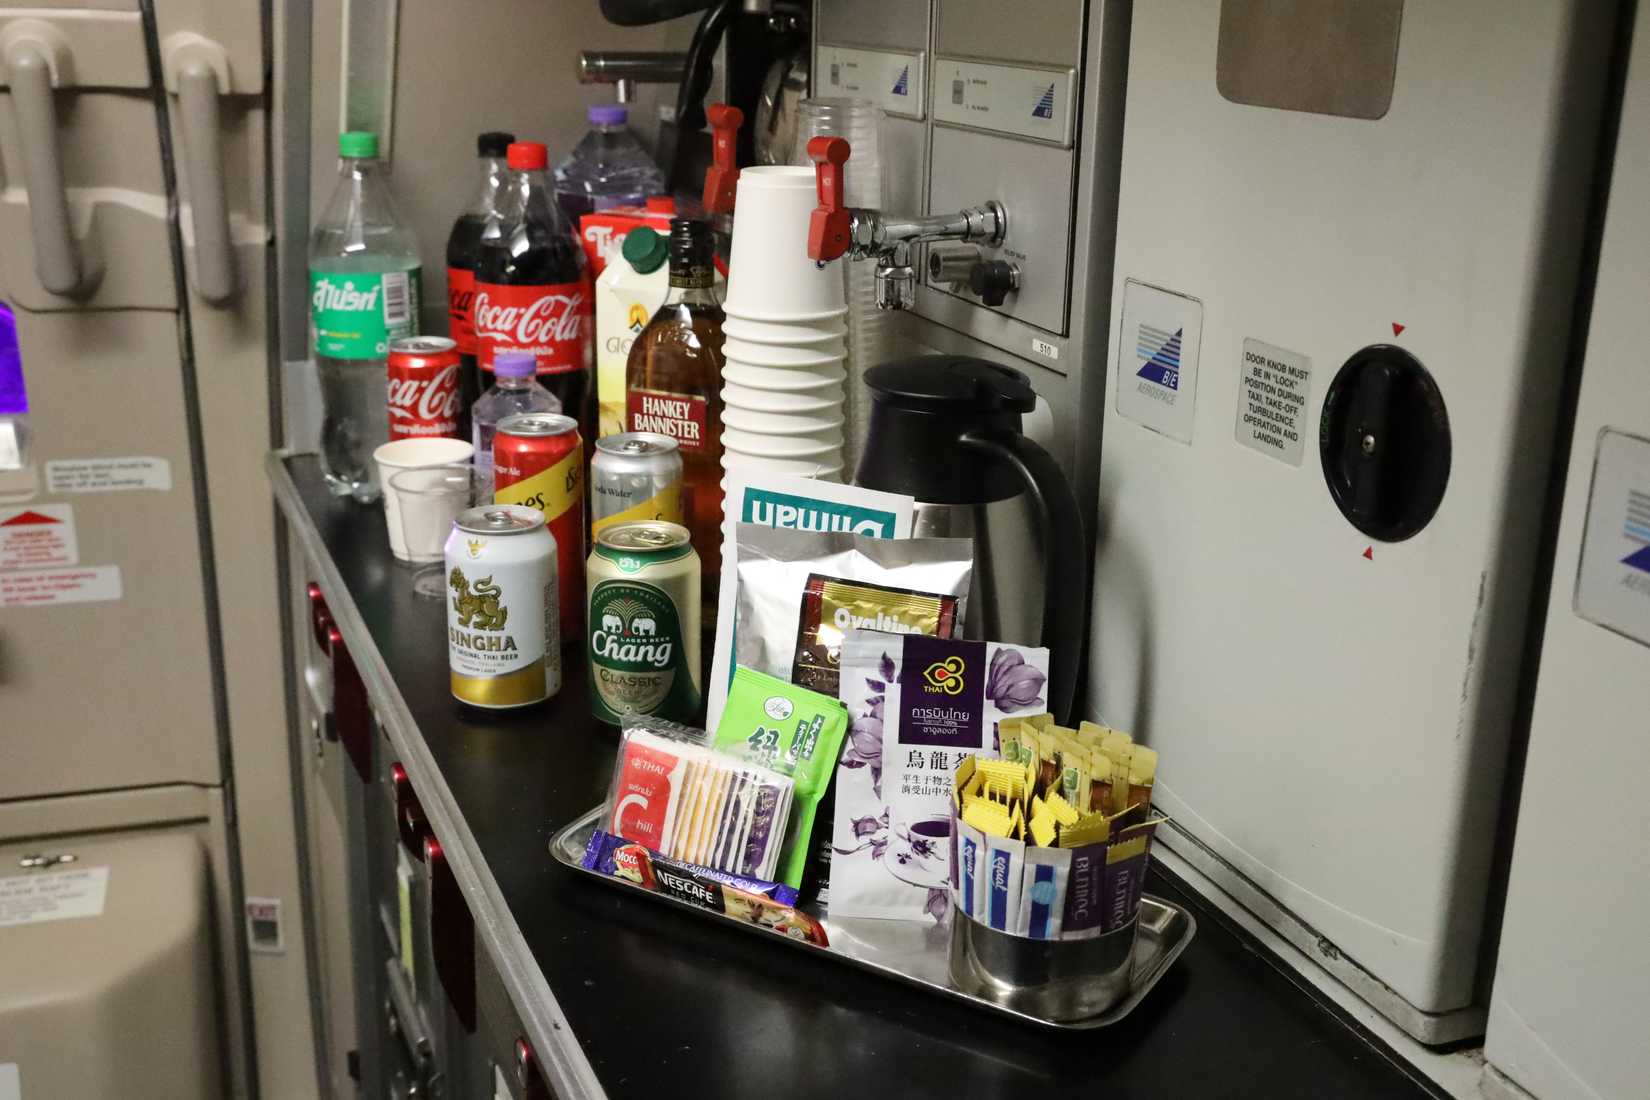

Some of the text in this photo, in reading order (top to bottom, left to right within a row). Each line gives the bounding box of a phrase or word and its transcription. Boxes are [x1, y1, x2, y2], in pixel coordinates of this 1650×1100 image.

[474, 292, 581, 343] Coca-Cola
[1040, 343, 1051, 356] 510
[1245, 352, 1309, 381] DOOR KNOB MUST
[1253, 367, 1262, 378] BE
[1264, 371, 1271, 380] IN
[1245, 376, 1305, 406] POSITION DURING
[642, 396, 690, 420] HANKEY
[634, 413, 700, 440] BANNISTER
[1243, 413, 1298, 442] OPERATION AND
[449, 626, 518, 652] SINGHA
[592, 629, 673, 668] Chang
[600, 668, 663, 687] CLASSIC
[923, 685, 943, 693] THAI
[643, 760, 665, 775] THAI
